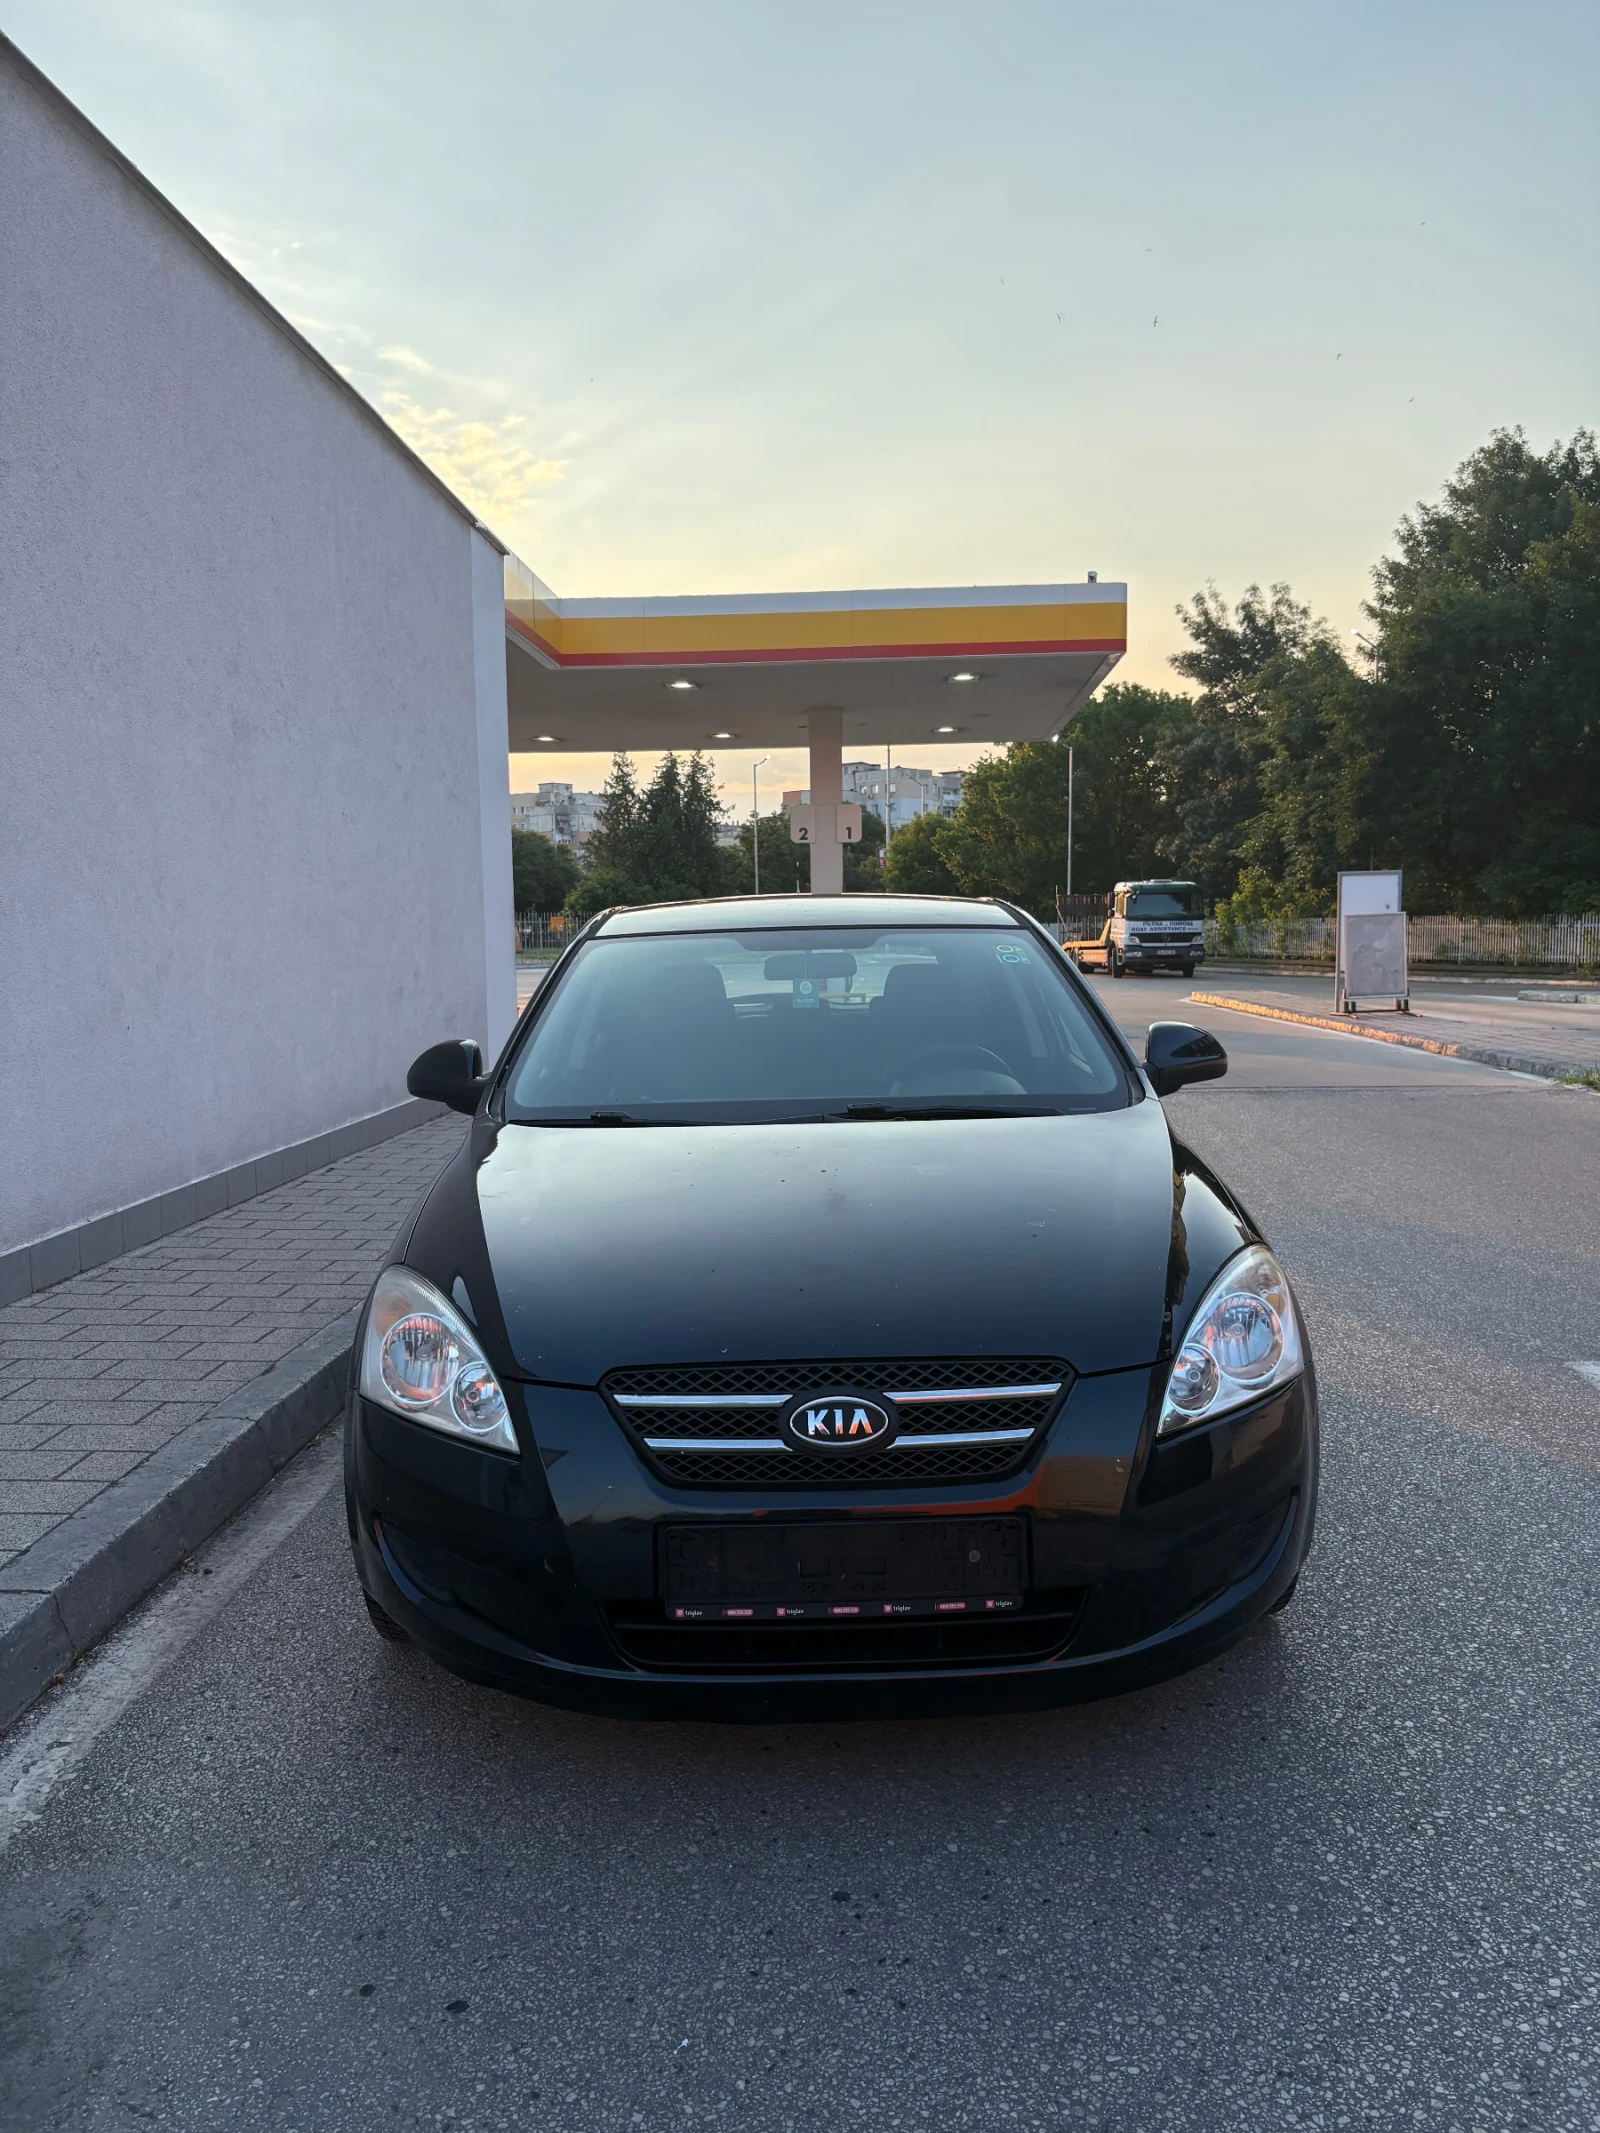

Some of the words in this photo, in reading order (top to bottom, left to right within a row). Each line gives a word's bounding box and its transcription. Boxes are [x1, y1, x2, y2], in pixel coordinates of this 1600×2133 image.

[798, 827, 809, 841] 2
[845, 826, 852, 840] 1
[806, 1408, 873, 1435] KIA
[786, 1608, 804, 1616] triglav
[893, 1604, 911, 1612] triglav
[995, 1600, 1012, 1608] triglav
